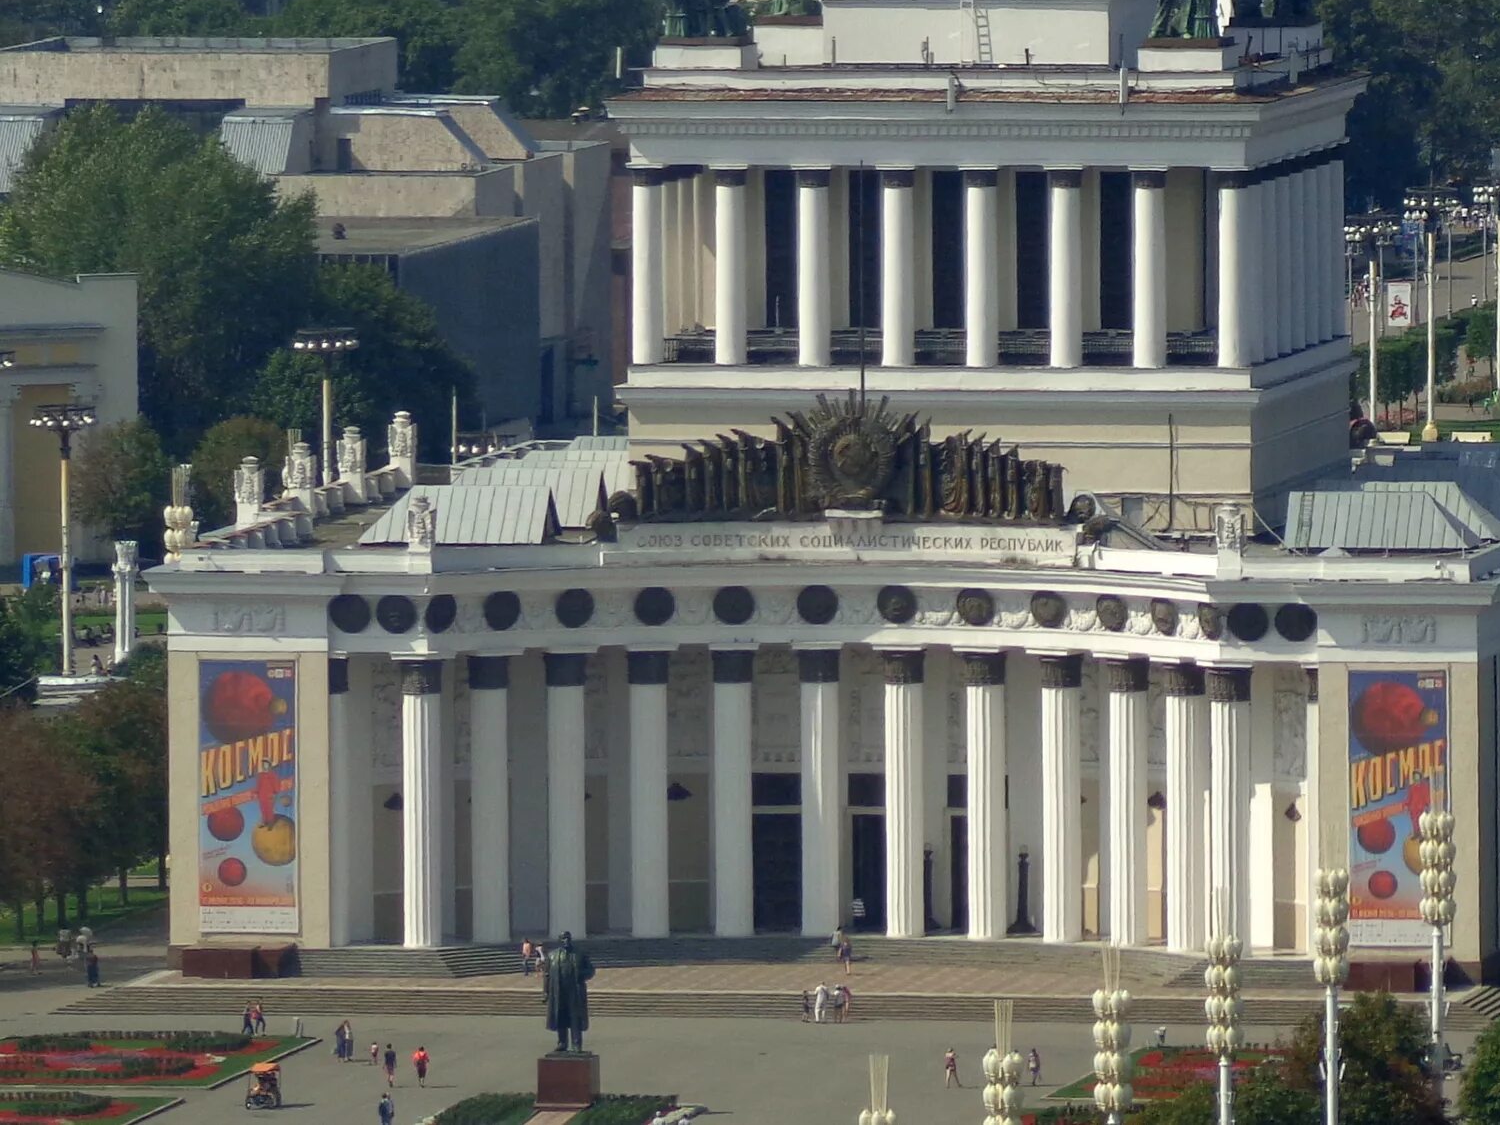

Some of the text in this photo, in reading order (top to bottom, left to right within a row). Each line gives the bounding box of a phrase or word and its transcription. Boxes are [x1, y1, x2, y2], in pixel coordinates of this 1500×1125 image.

[636, 534, 1064, 553] СОЮЗ СОВЕТСКИХ СОЦИАЛИСТИЧЕСКИХ РЕСПУБЛИК
[201, 726, 293, 797] КОСМОС
[1351, 739, 1446, 810] КОСМОС
